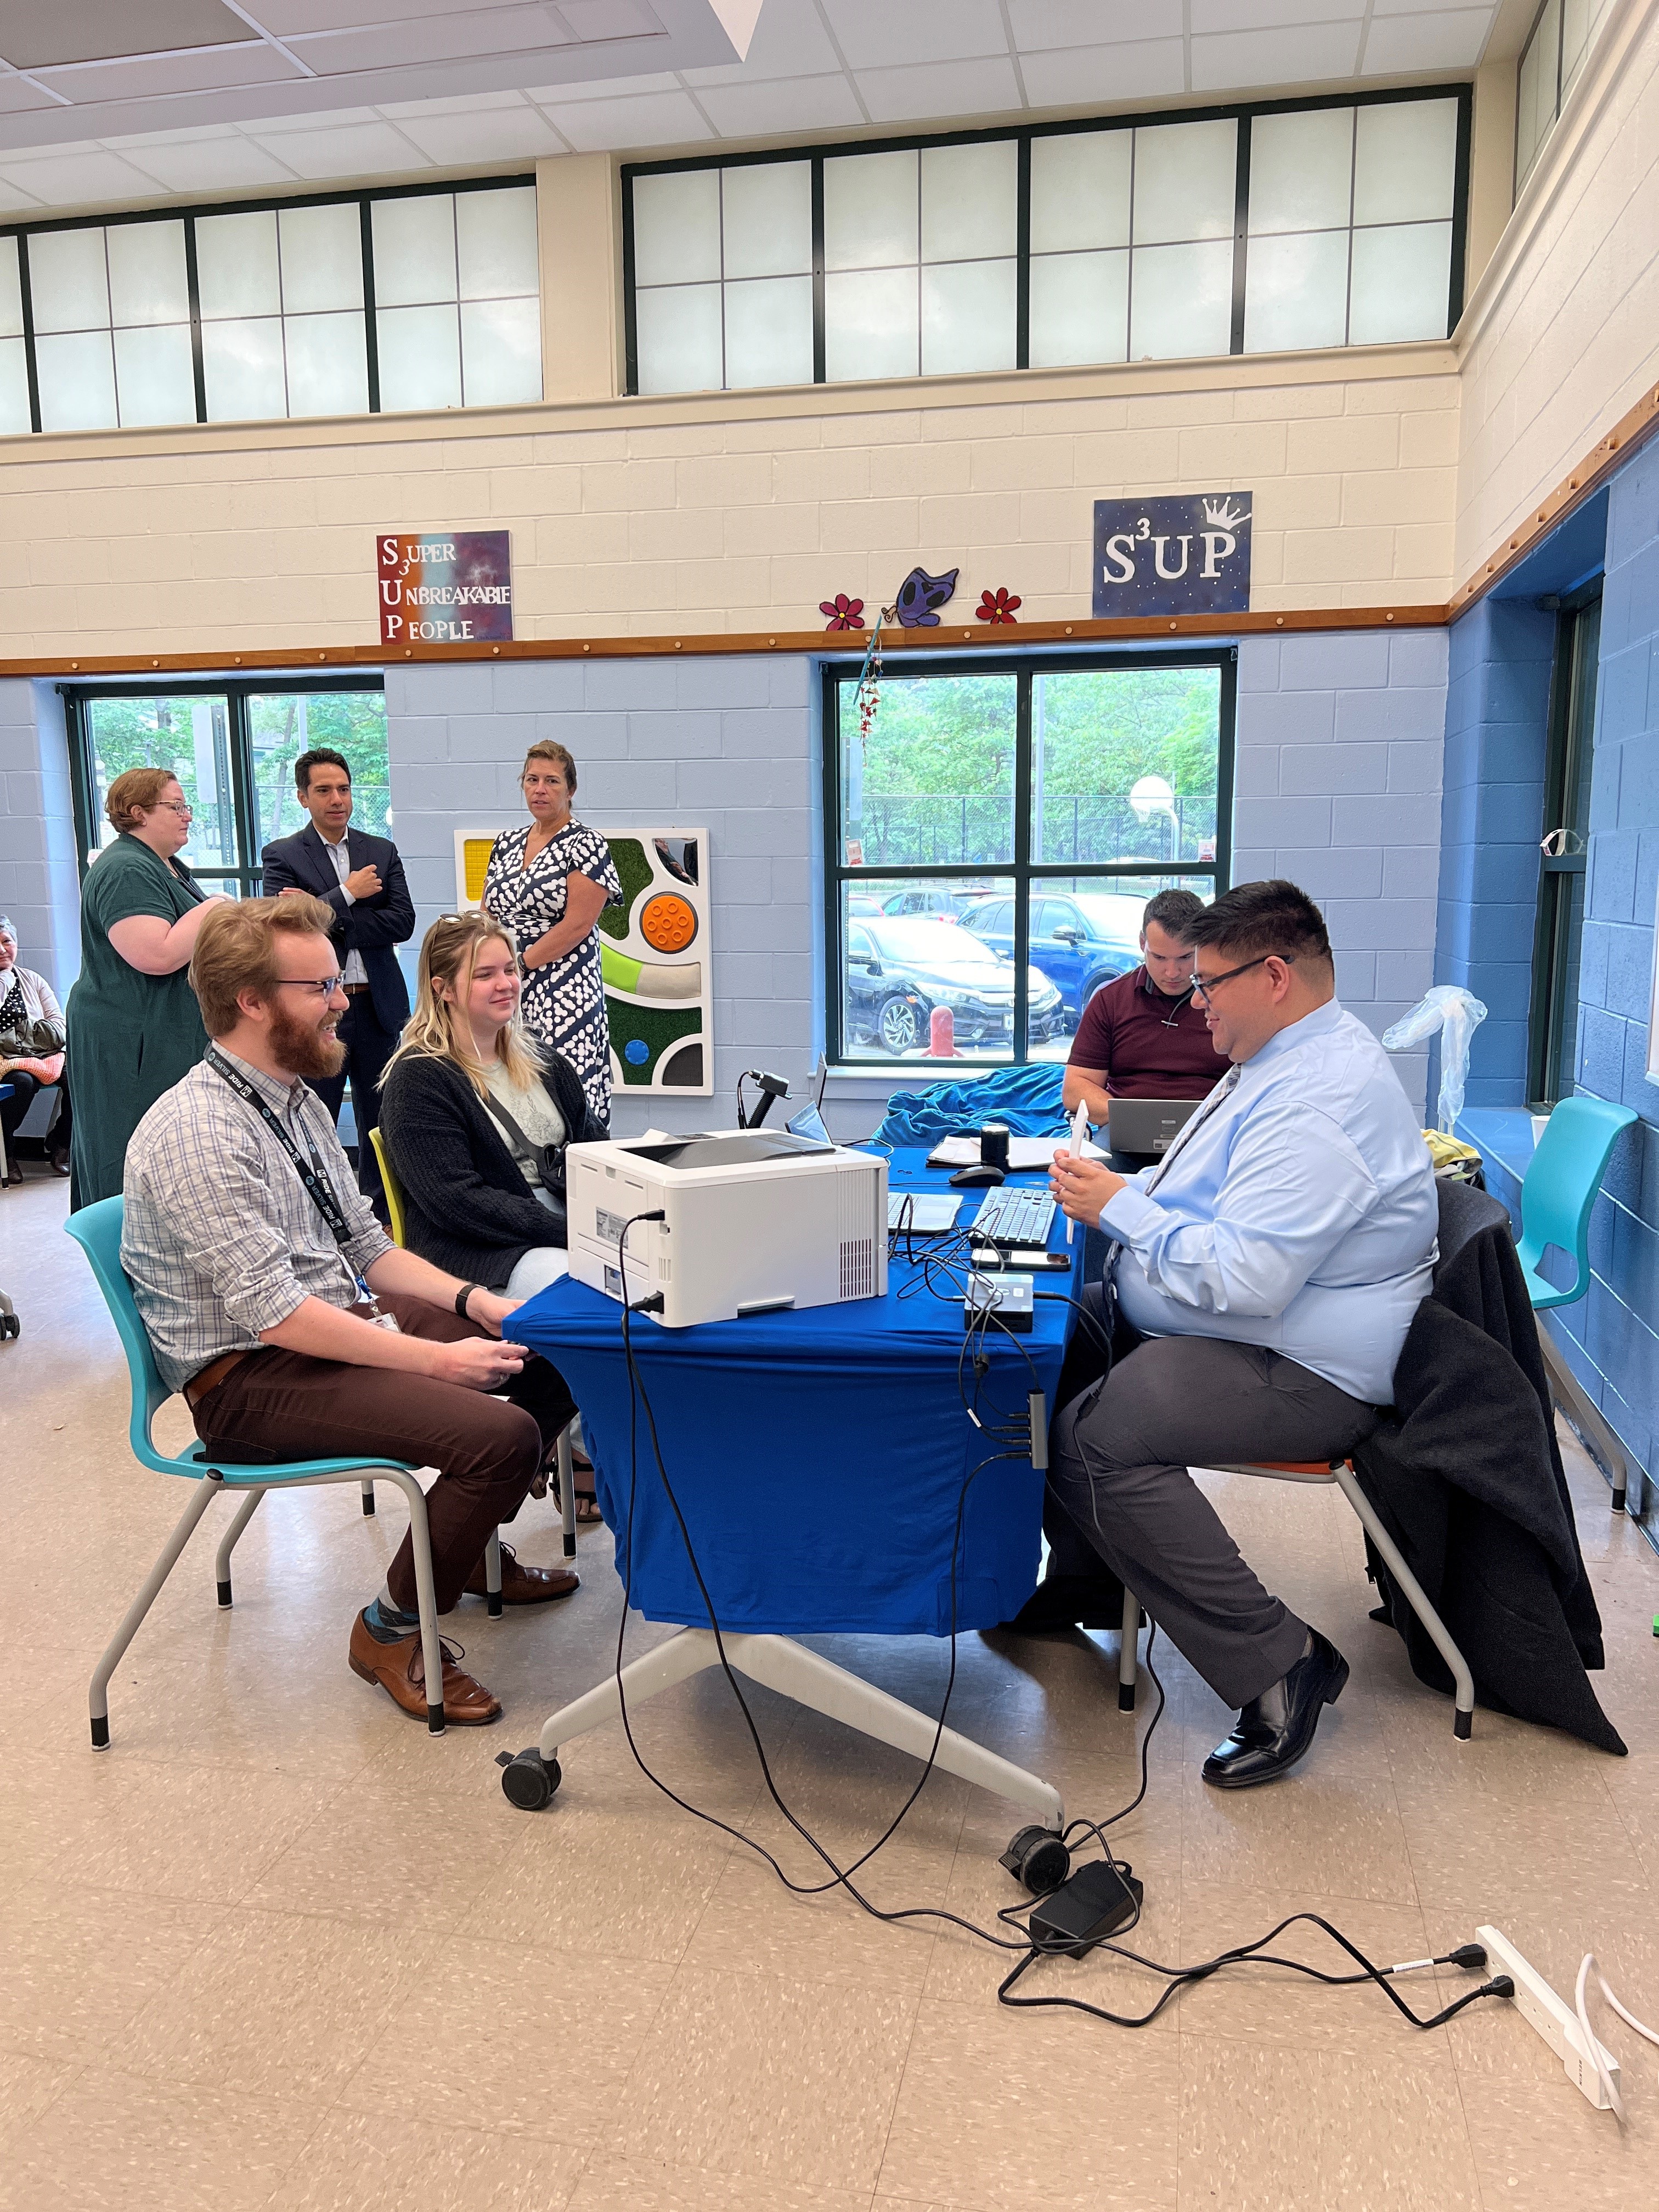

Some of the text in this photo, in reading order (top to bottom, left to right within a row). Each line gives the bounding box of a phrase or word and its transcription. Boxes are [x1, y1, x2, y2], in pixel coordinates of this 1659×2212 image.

[382, 538, 456, 566] SUPER
[380, 579, 511, 606] UNBREAKABLE
[386, 614, 474, 640] PEOPLE
[213, 1058, 230, 1075] SILVER
[228, 1074, 244, 1088] RIDE
[269, 1118, 285, 1138] SILVER
[283, 1138, 294, 1153] RIDE
[321, 1178, 331, 1194] RIDE
[312, 1186, 326, 1205] SILVER
[323, 1205, 335, 1220] RIDE
